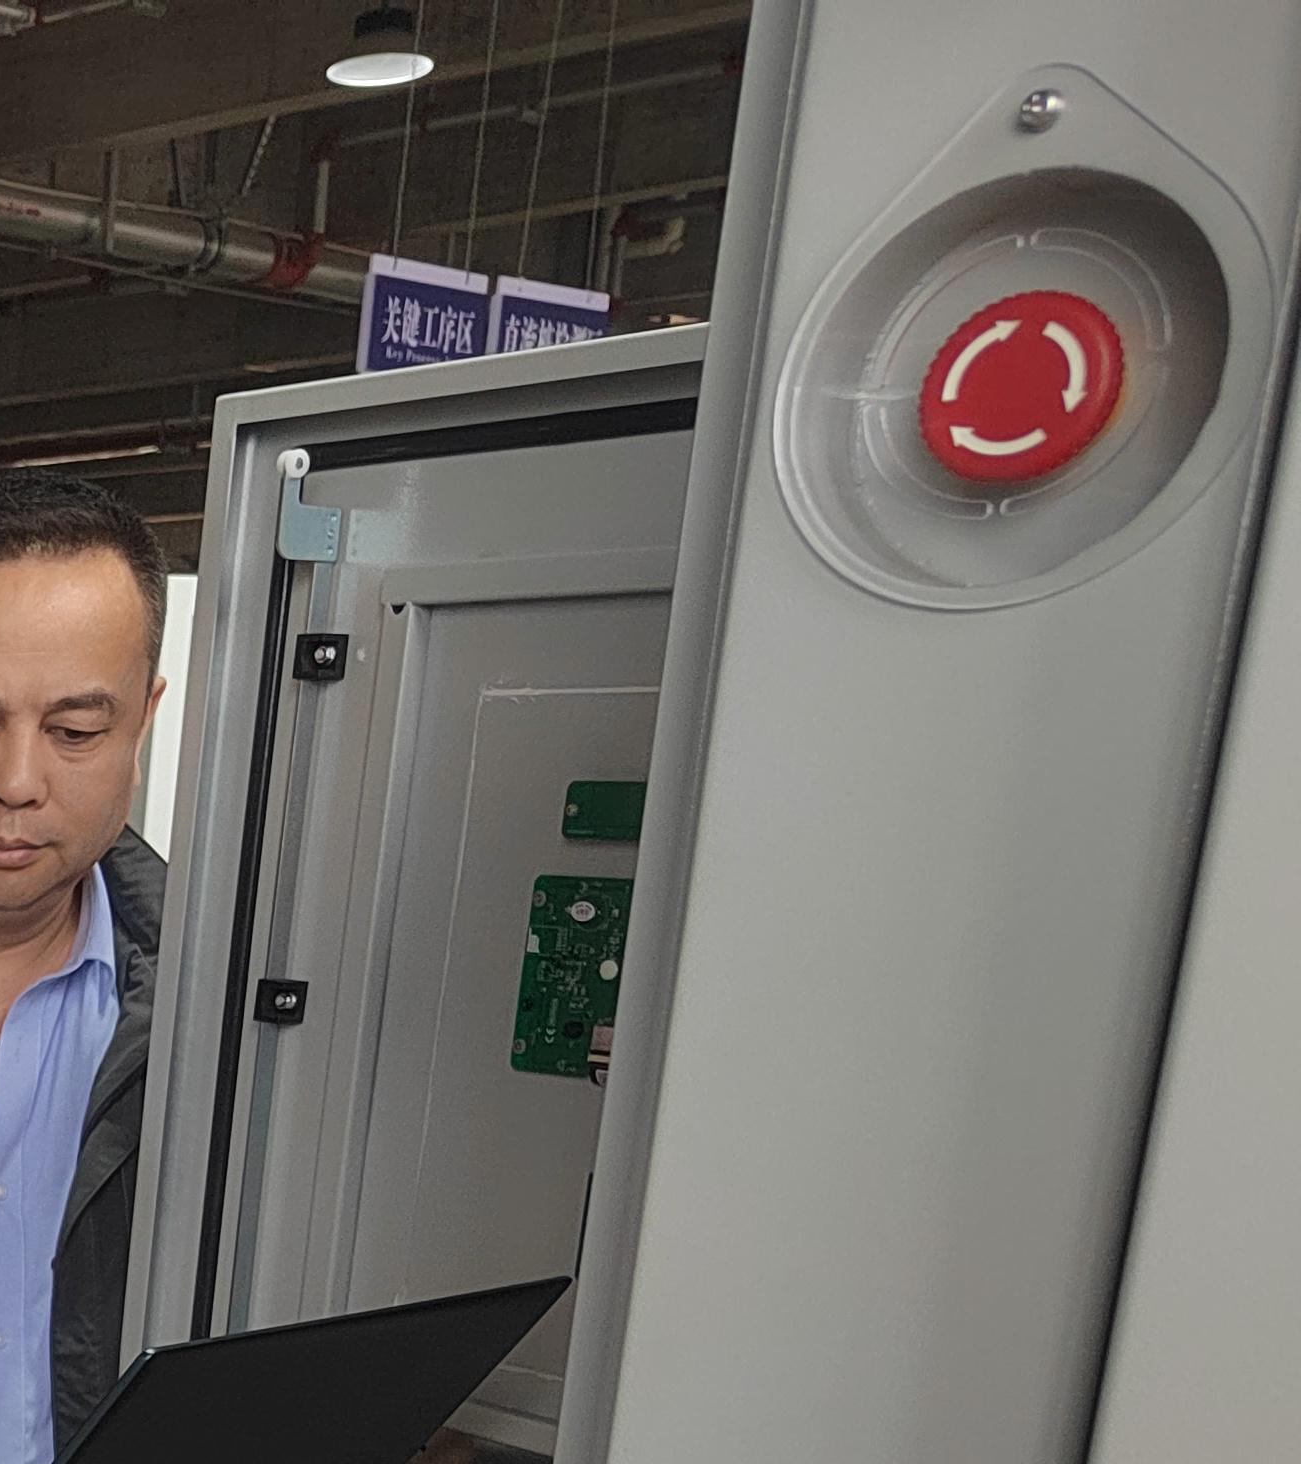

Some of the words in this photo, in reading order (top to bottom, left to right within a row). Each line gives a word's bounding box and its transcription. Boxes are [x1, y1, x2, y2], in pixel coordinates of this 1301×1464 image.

[381, 295, 475, 354] 关键工序区
